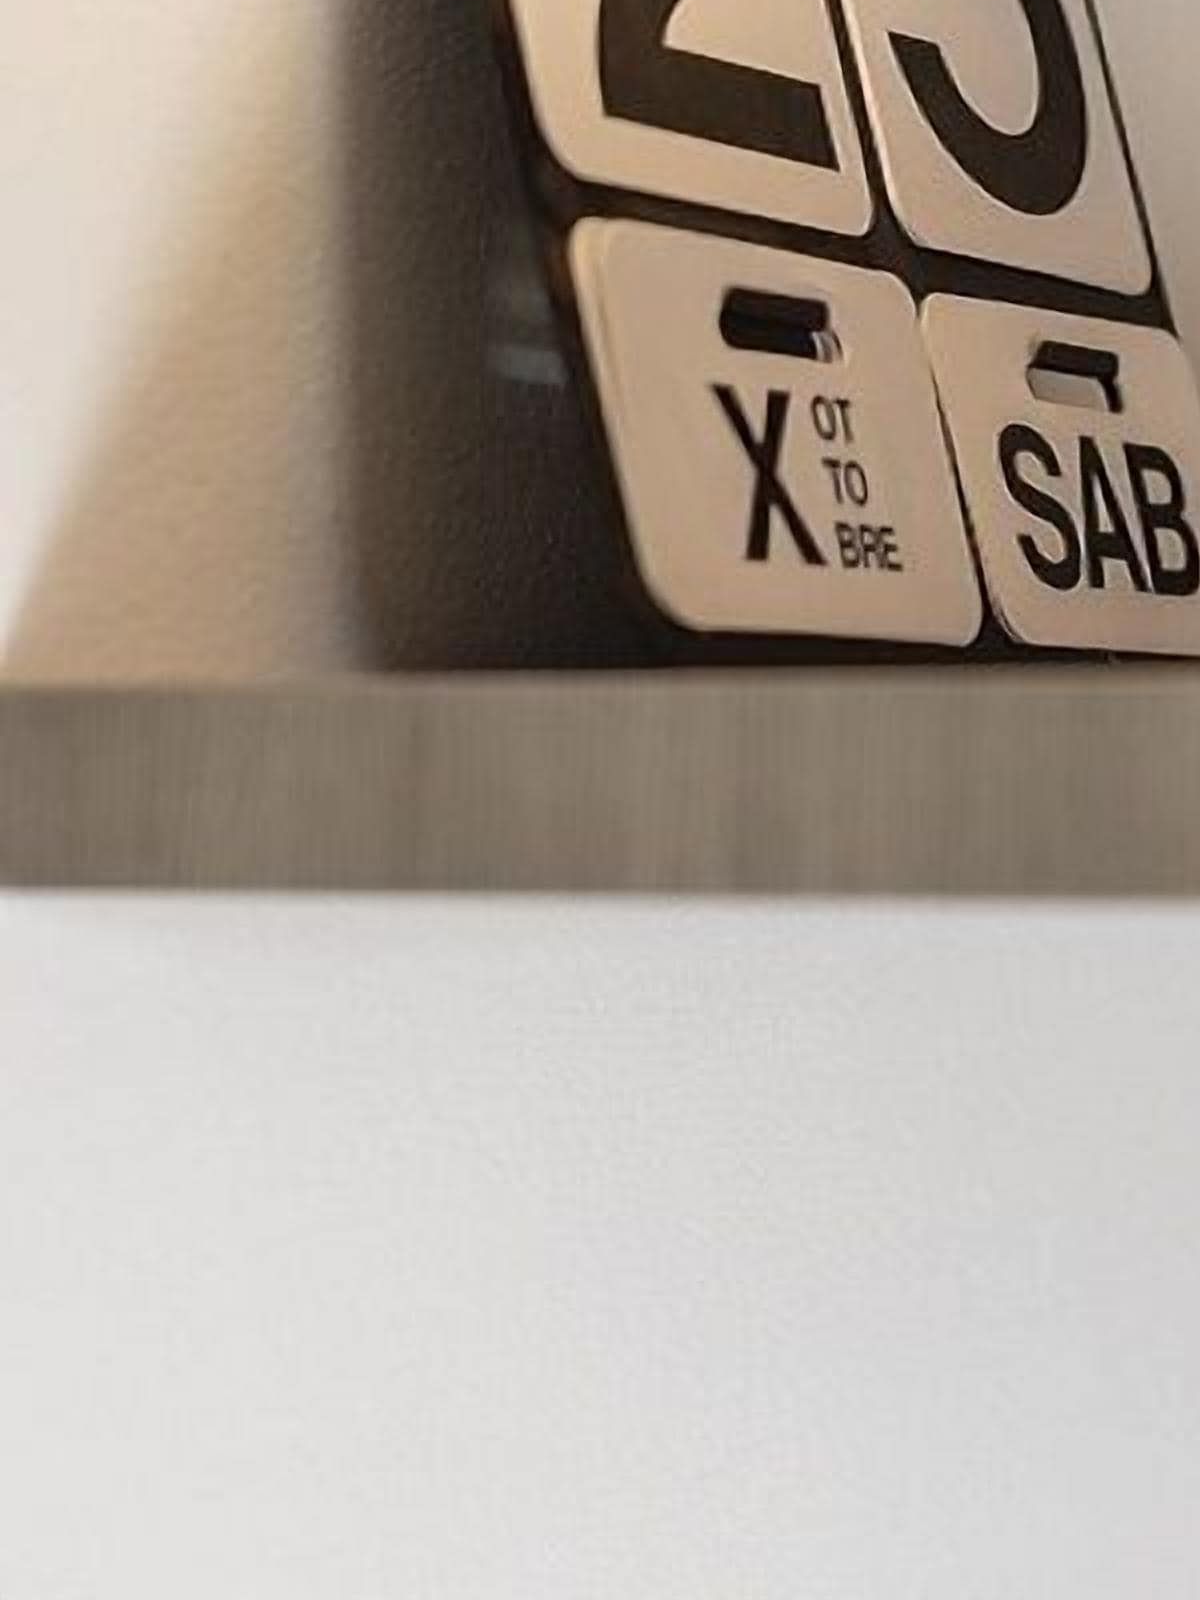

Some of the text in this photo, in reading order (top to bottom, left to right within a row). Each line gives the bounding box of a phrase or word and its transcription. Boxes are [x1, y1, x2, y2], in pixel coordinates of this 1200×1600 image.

[810, 394, 855, 443] OT
[709, 383, 829, 567] X
[821, 457, 869, 508] TO
[997, 423, 1200, 598] SAB
[834, 521, 904, 573] BRE
